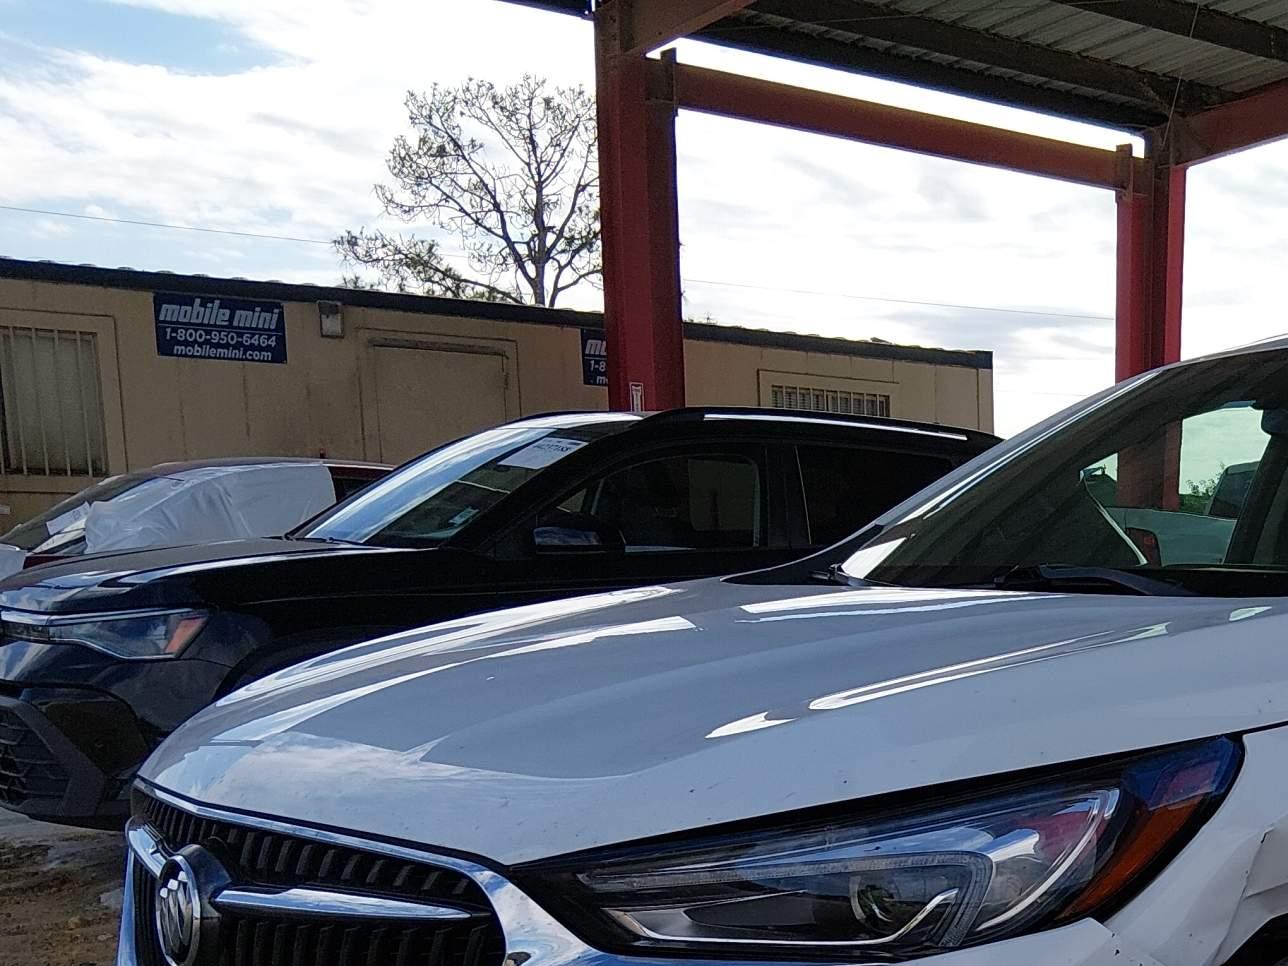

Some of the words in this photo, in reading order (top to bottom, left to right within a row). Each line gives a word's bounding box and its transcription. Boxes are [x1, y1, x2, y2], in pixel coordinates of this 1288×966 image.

[159, 298, 230, 325] mobile
[233, 307, 279, 329] mini
[165, 328, 276, 347] 1-800-950-6464
[173, 343, 272, 360] mobilemini.com
